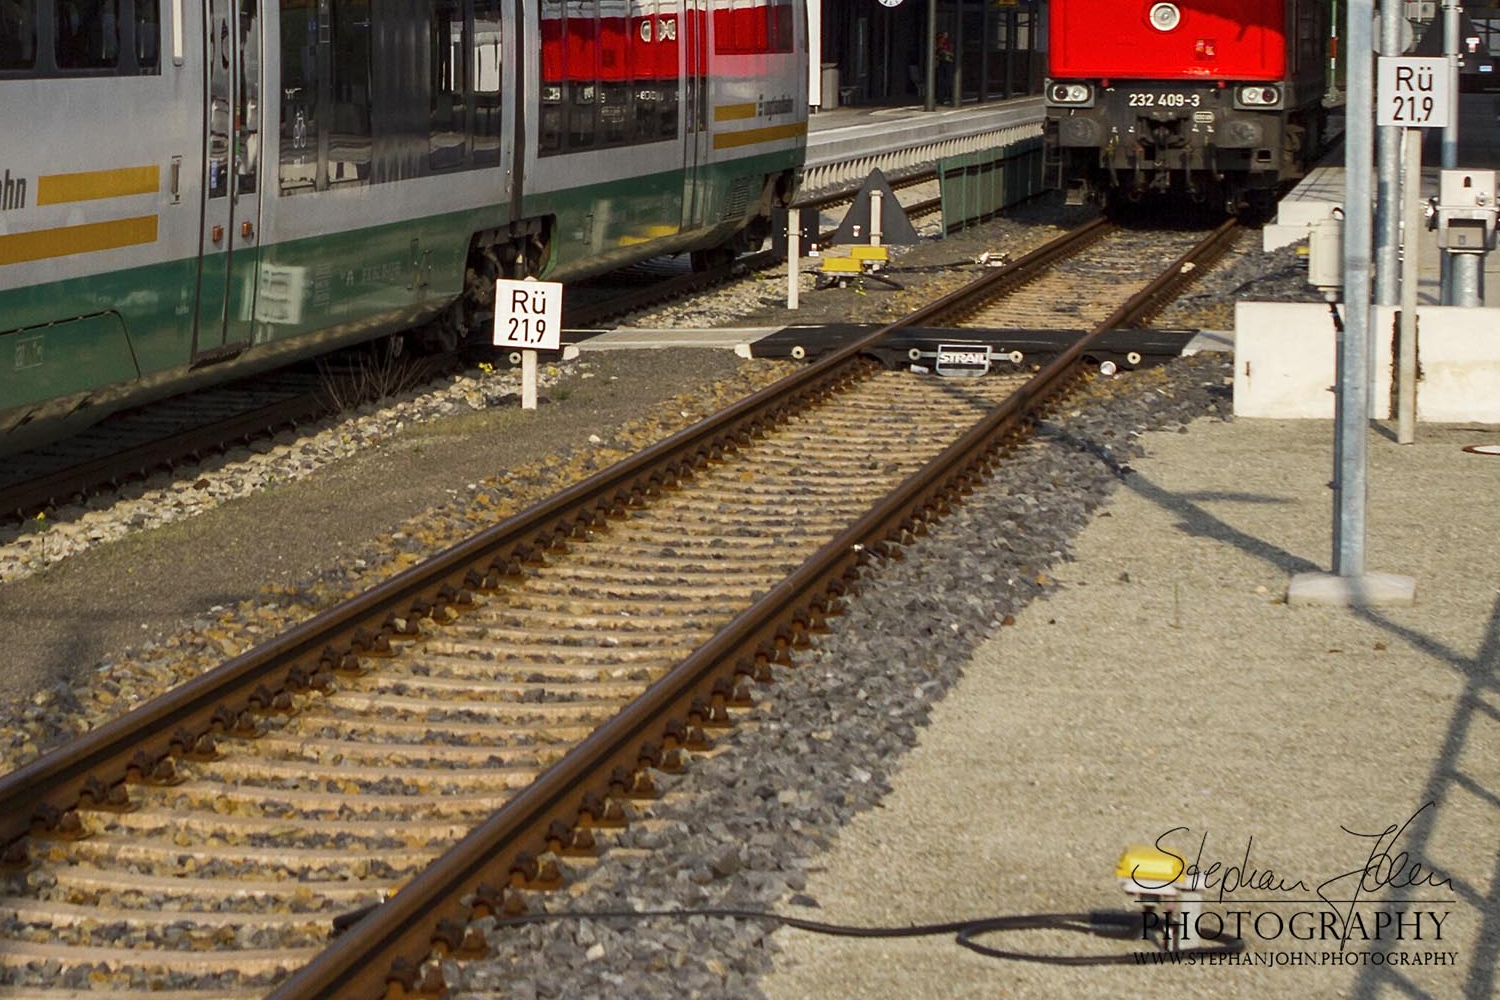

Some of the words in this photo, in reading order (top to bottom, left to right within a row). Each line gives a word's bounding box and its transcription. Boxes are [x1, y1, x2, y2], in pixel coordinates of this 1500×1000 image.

[1395, 66, 1433, 92] Rü
[1129, 94, 1154, 106] 232
[1158, 94, 1200, 107] 409-3
[1393, 96, 1434, 123] 21,9
[512, 290, 546, 315] Rü
[507, 317, 546, 344] 21,9
